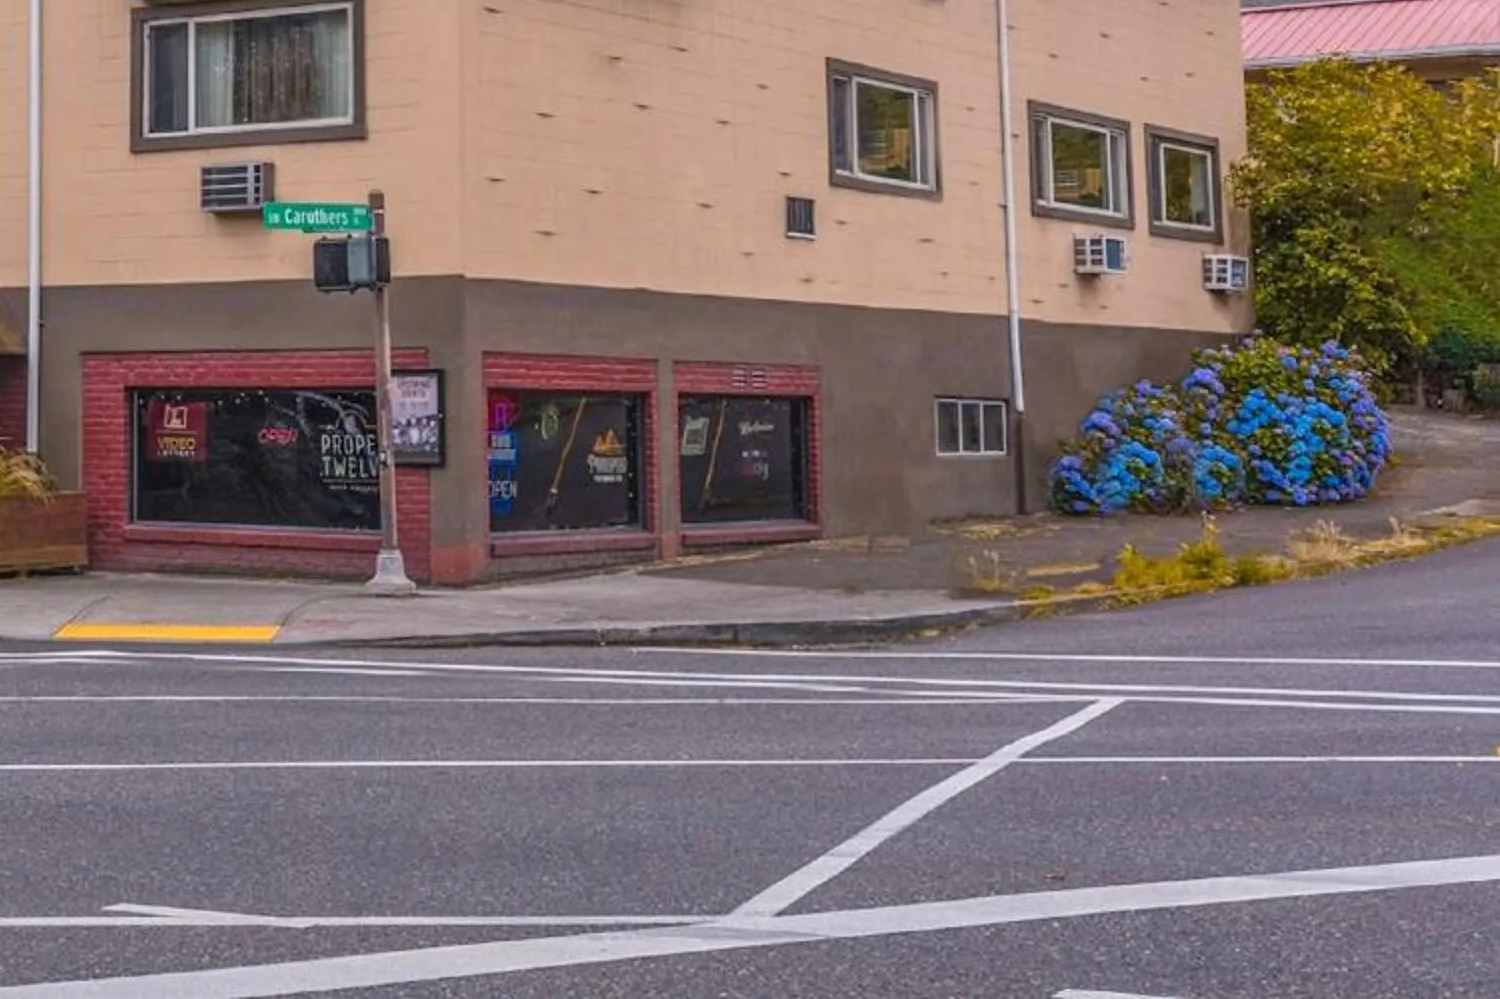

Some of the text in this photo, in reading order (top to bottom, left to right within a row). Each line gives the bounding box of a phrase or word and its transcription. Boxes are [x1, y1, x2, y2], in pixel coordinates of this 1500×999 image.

[284, 208, 349, 226] Caruthers
[156, 436, 196, 450] VIDEO
[320, 434, 377, 456] PROPE
[321, 456, 379, 479] TWELV
